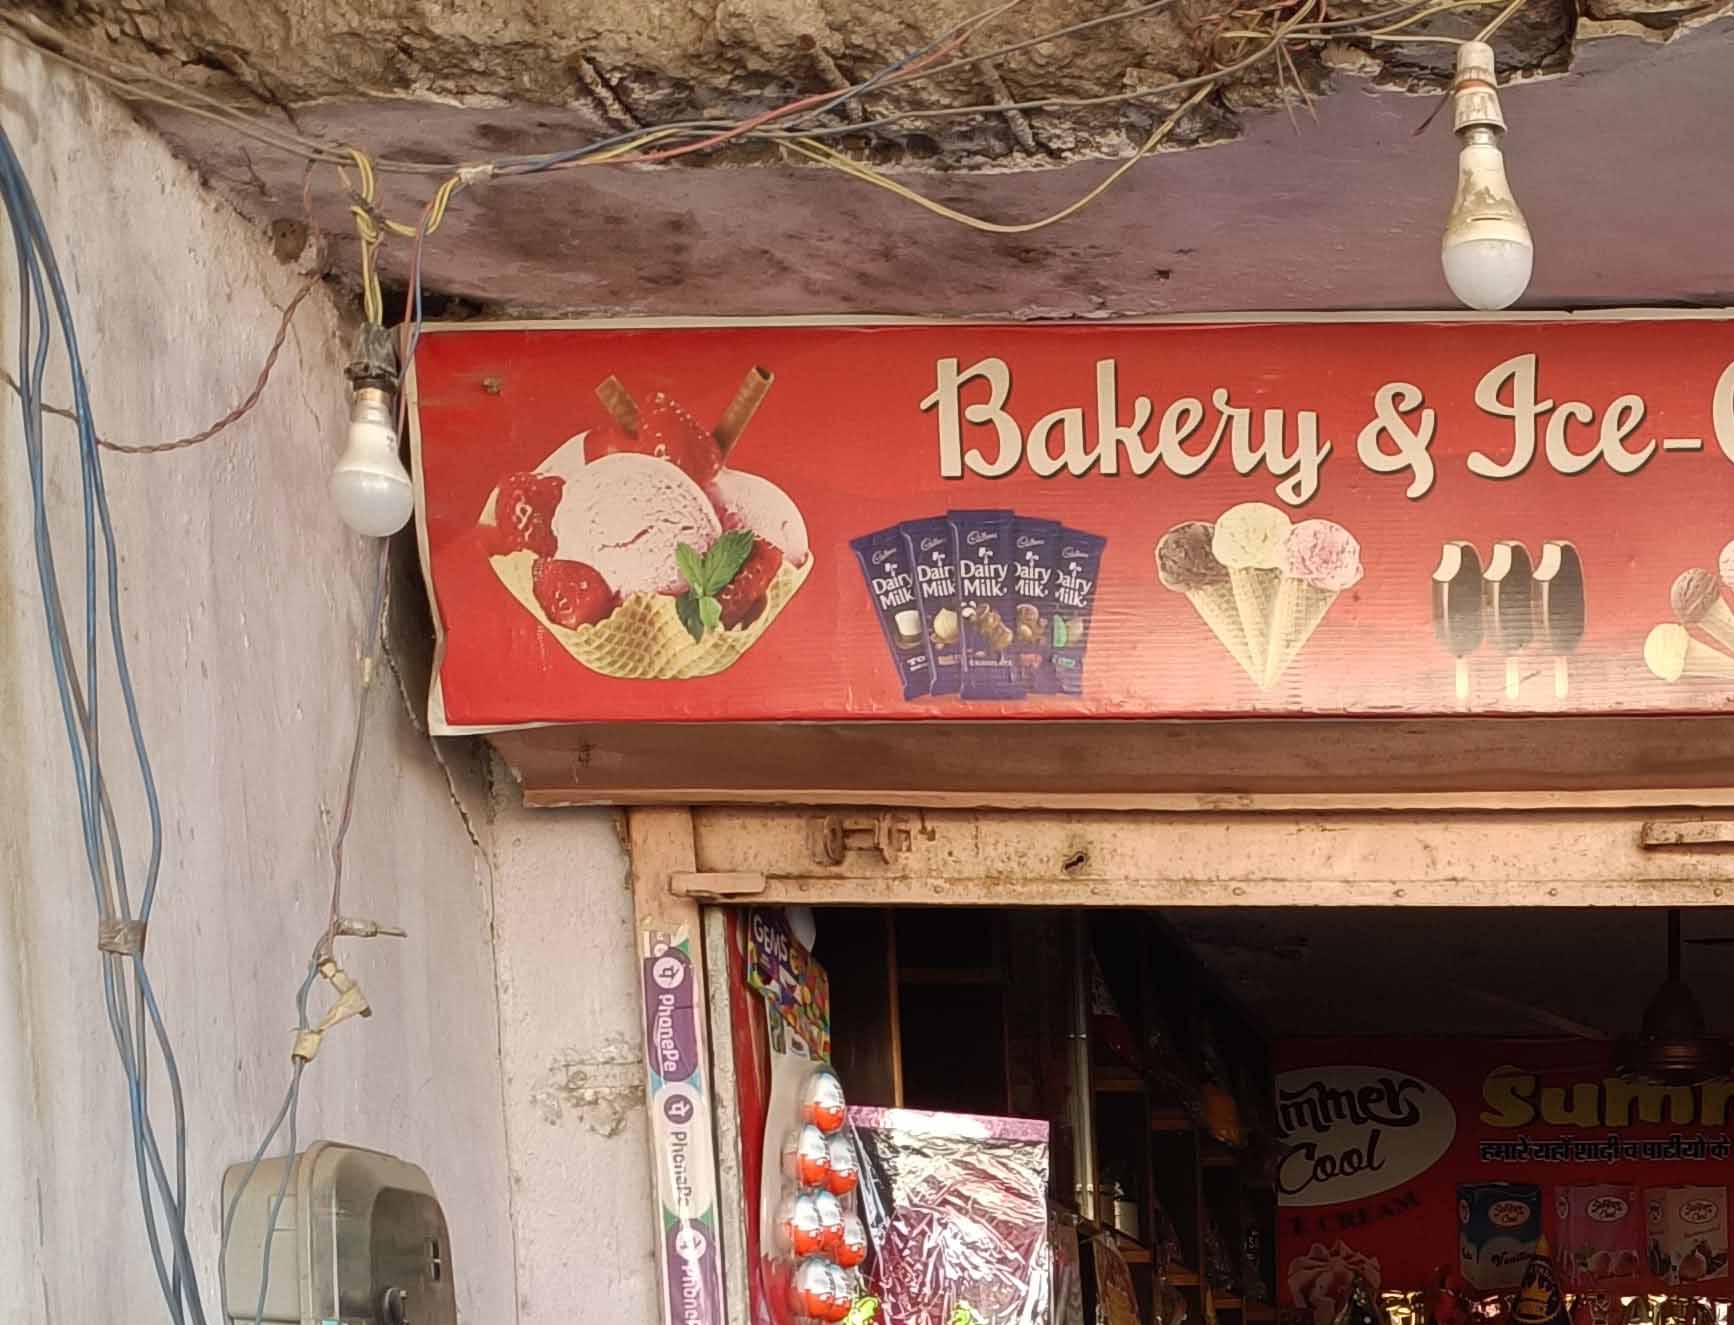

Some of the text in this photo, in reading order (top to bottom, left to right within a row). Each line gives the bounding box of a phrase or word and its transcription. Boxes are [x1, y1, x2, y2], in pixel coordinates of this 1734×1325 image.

[920, 357, 1332, 507] Bakery
[1355, 382, 1438, 499] &
[960, 560, 1008, 582] Dairy
[963, 581, 1003, 597] Milk
[1278, 1127, 1387, 1195] Cool
